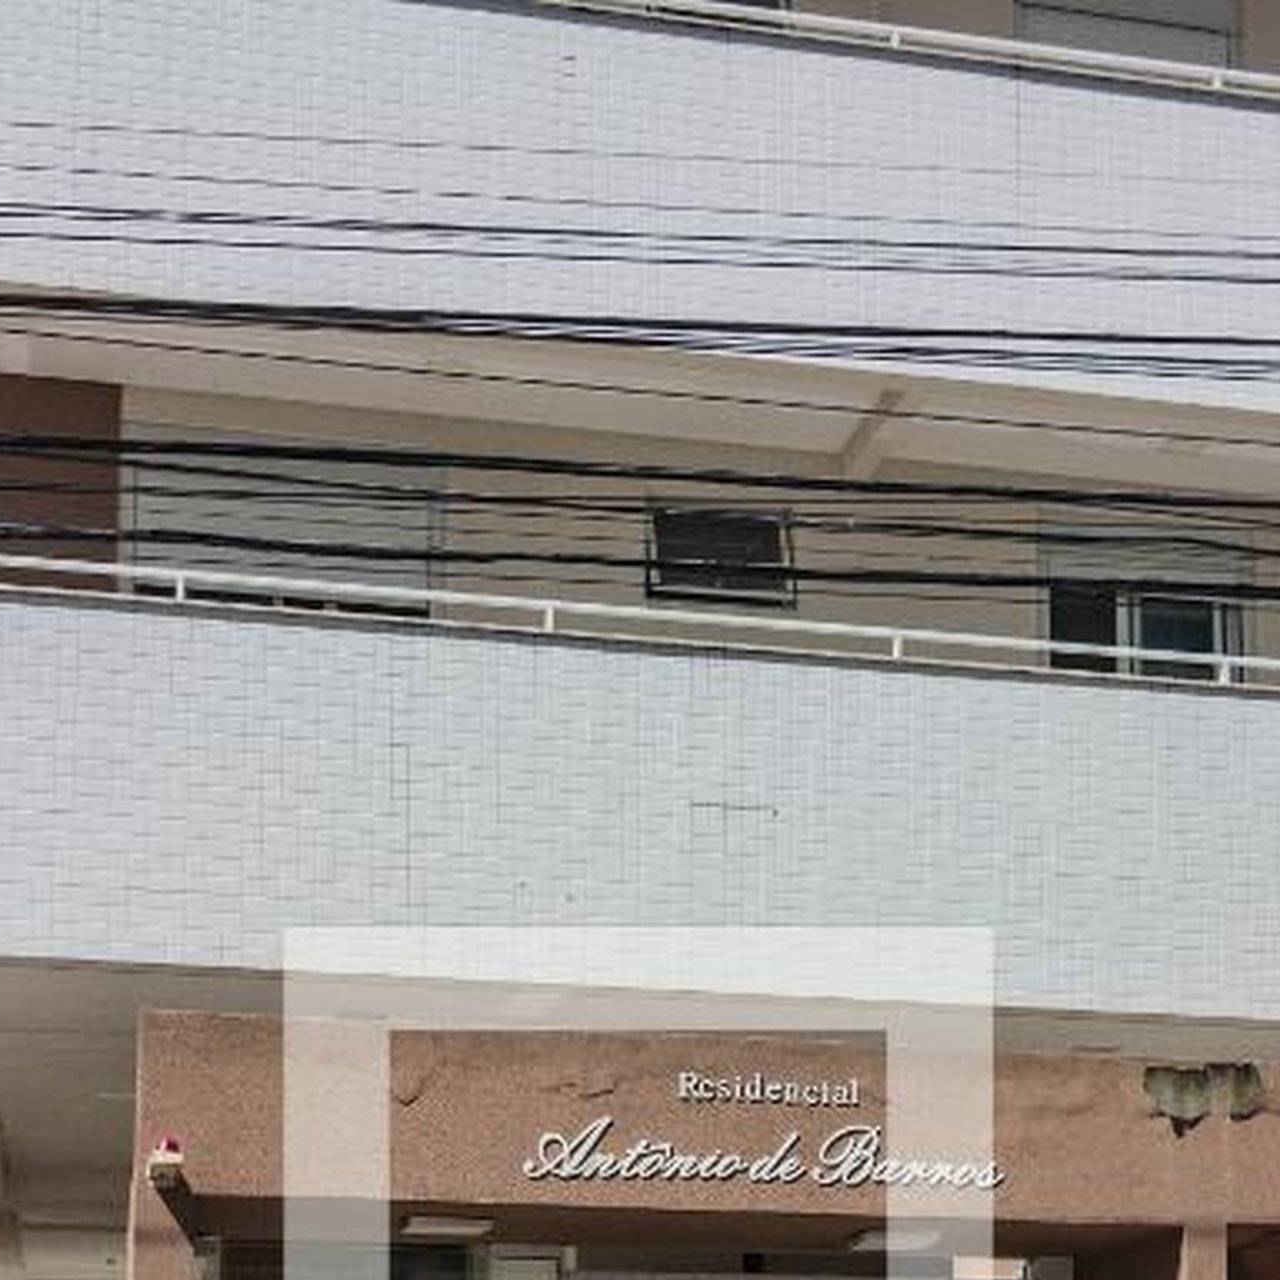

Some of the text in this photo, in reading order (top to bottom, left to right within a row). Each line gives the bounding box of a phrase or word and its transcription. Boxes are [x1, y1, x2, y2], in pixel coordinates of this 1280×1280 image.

[677, 1071, 861, 1106] Residencial
[523, 1115, 1005, 1187] Antônio de Barros
